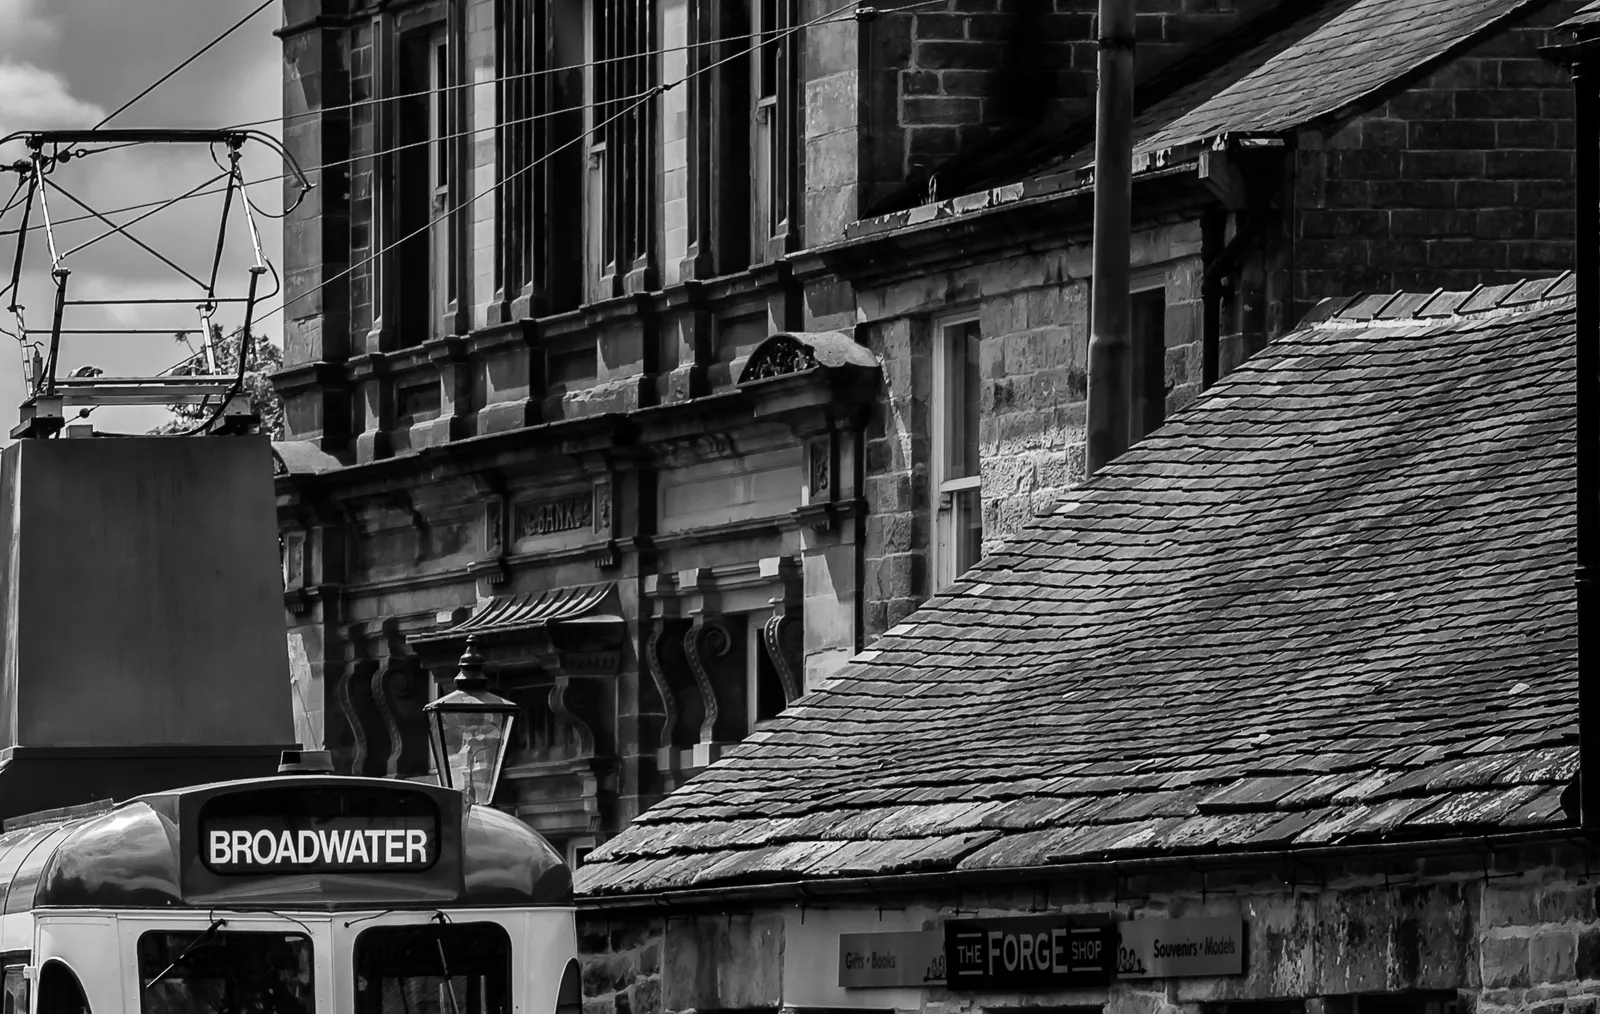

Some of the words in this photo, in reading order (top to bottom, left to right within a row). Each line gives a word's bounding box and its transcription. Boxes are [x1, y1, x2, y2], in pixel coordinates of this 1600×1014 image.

[538, 500, 576, 534] BANK
[210, 829, 428, 865] BROADWATER
[845, 951, 865, 970] Gifts
[871, 951, 897, 969] Books
[957, 944, 983, 964] THE
[987, 928, 1068, 976] FORGE
[1071, 940, 1102, 961] SHOP
[1153, 937, 1198, 959] Souvenirs
[1204, 934, 1236, 956] Models
